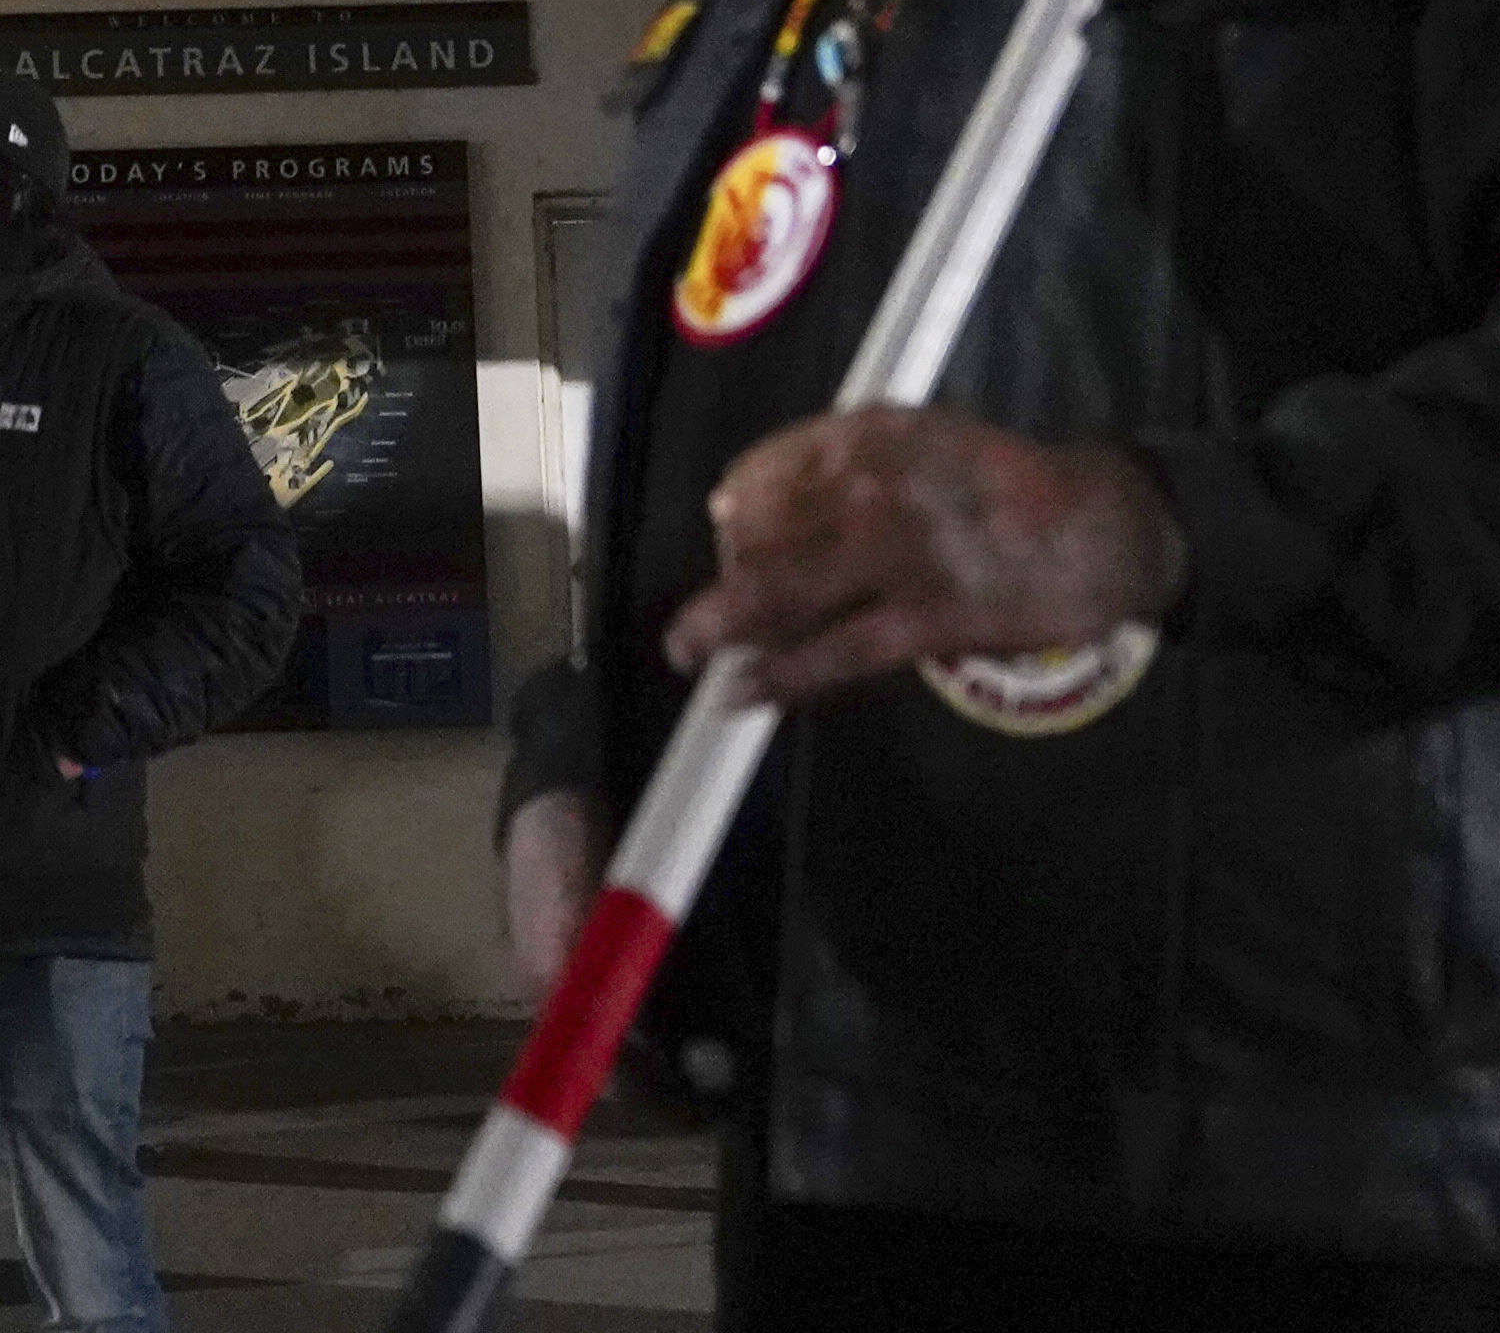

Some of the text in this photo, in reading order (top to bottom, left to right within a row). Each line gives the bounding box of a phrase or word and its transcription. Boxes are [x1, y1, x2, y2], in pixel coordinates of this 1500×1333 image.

[106, 9, 354, 30] WELCOME TO
[14, 38, 497, 82] ALCATRAZ ISLAND
[70, 153, 436, 186] ODAY'S PROGRAMS
